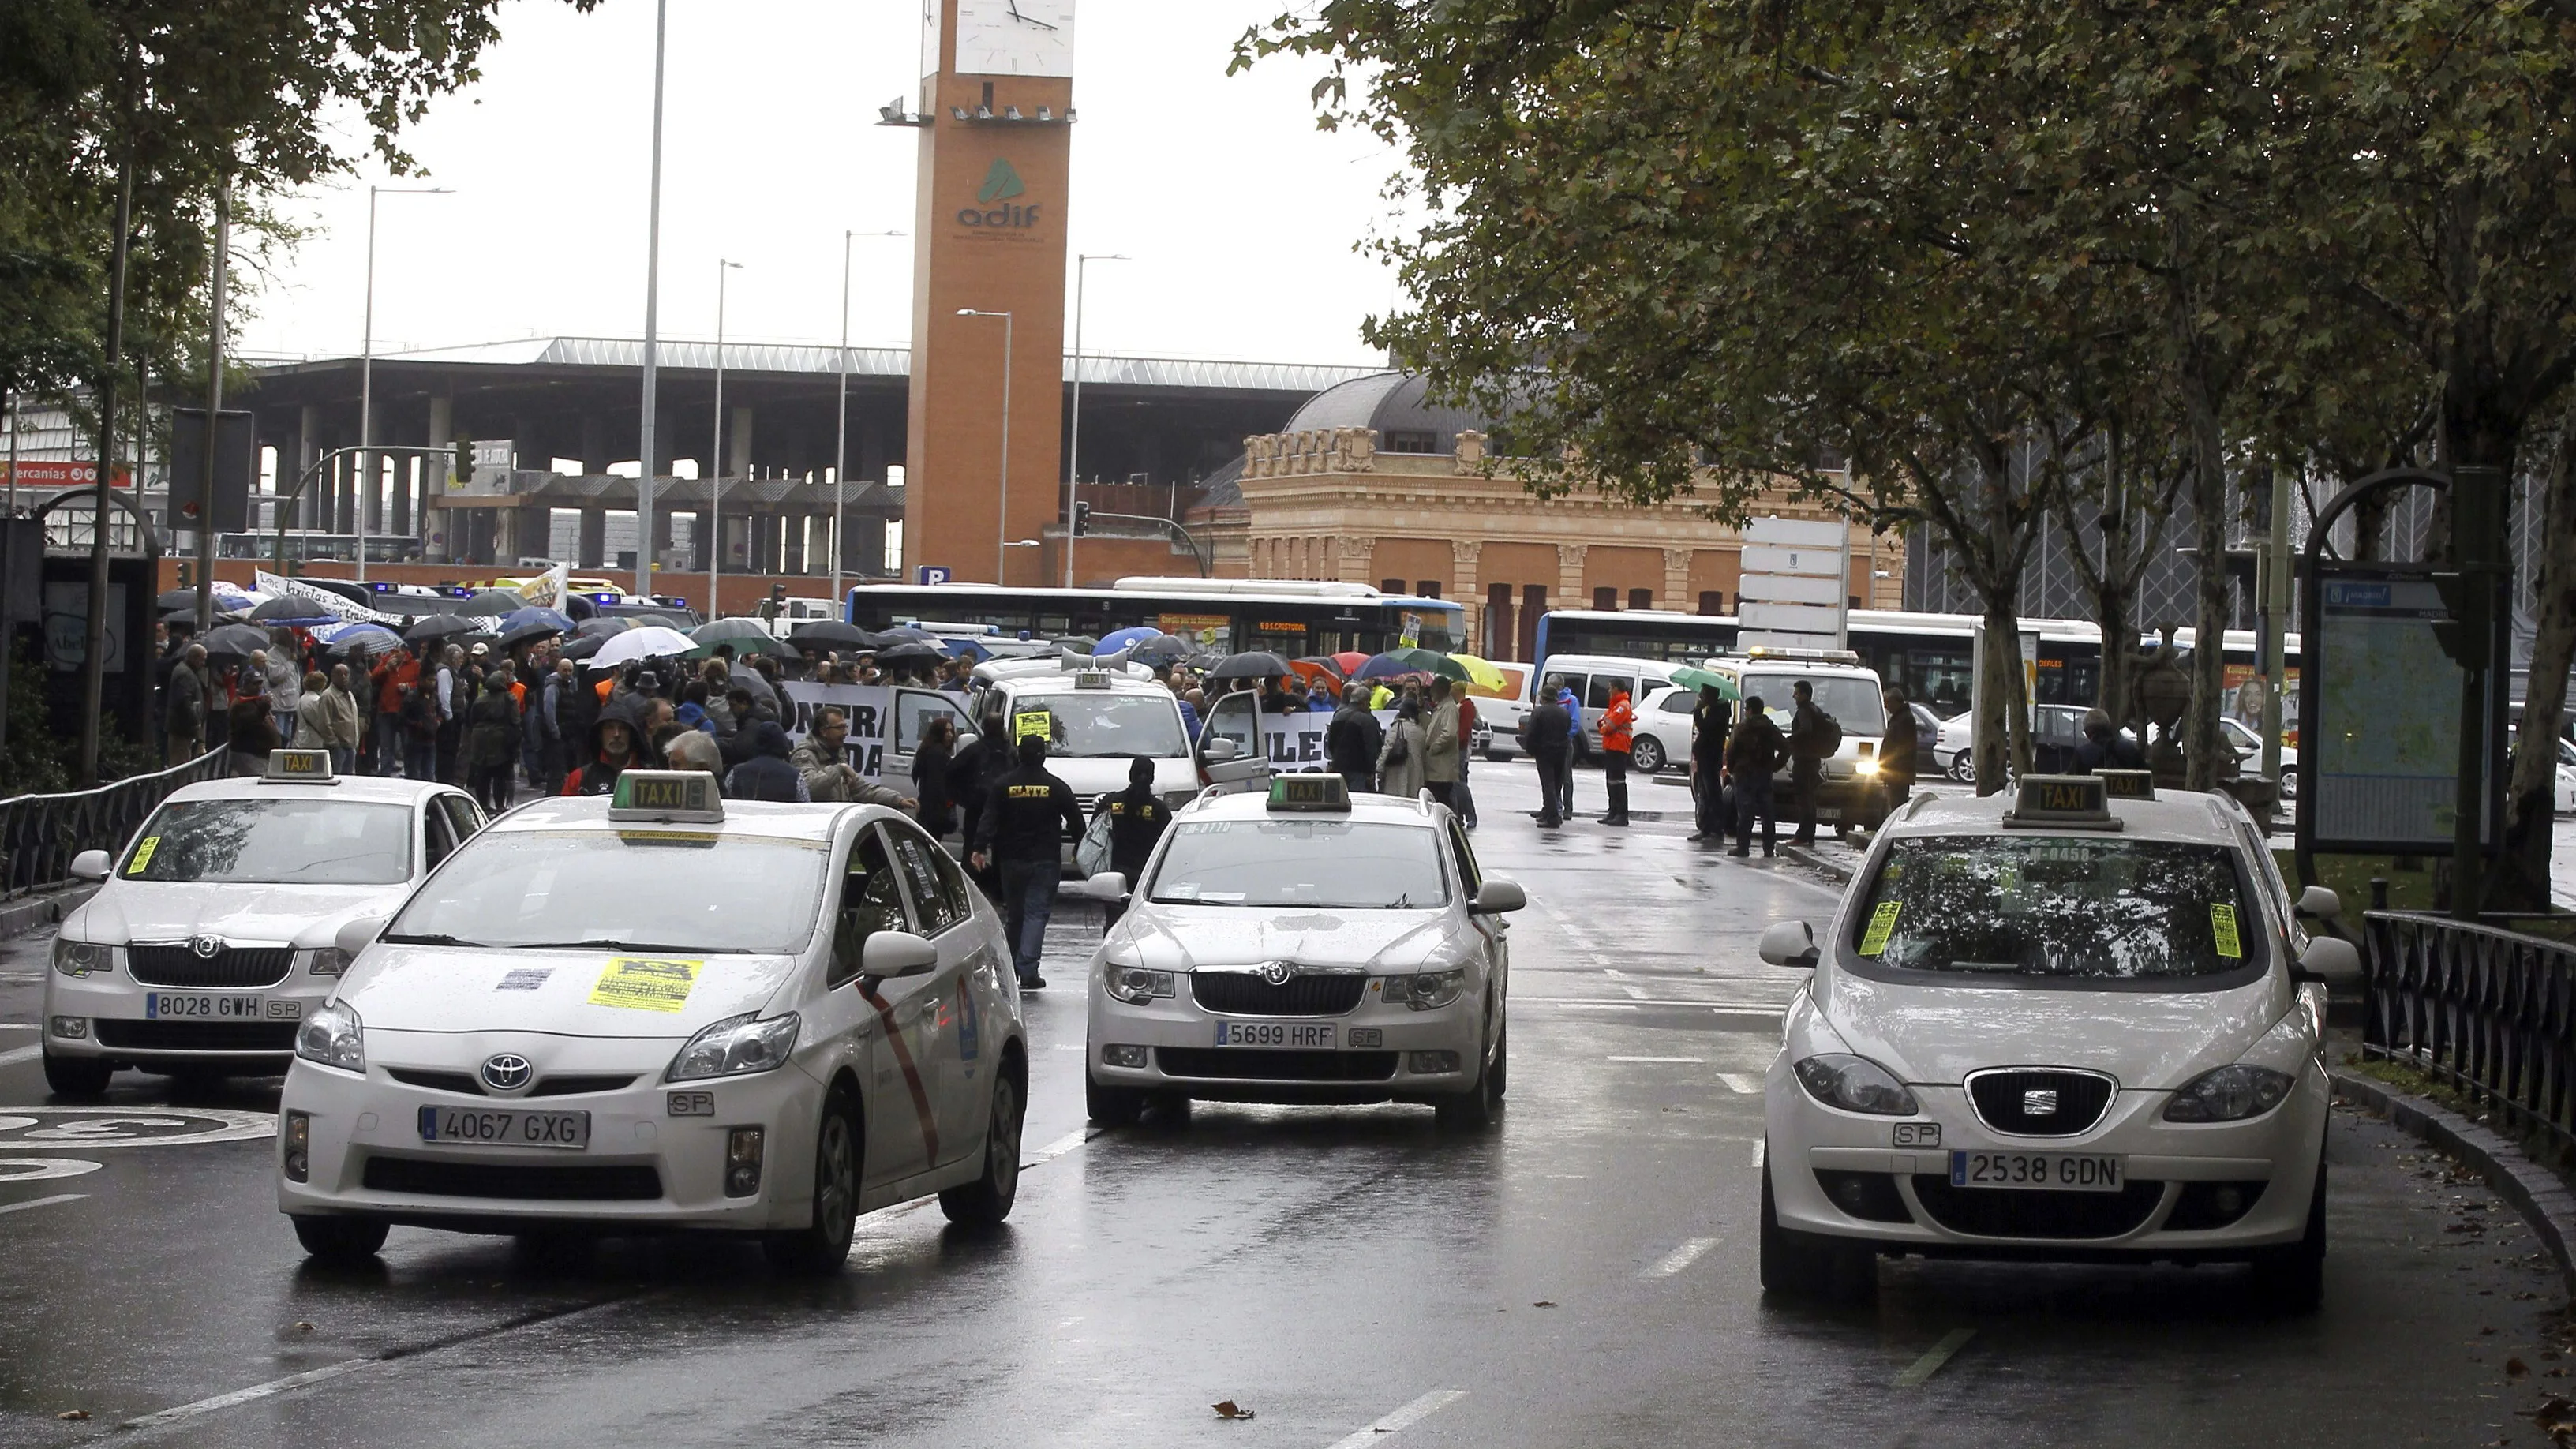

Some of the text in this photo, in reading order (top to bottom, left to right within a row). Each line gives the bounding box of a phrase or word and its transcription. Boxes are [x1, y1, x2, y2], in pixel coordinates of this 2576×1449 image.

[9, 467, 66, 480] ercanías
[928, 569, 944, 586] P
[285, 578, 328, 603] Taxistas
[284, 754, 313, 771] TAXI
[637, 782, 680, 804] TAXI
[1009, 785, 1050, 798] ELITE
[1290, 782, 1322, 799] TAXI
[2107, 777, 2138, 793] TAXI
[2041, 784, 2084, 808] TAXI
[2029, 848, 2090, 862] M-0458
[160, 997, 257, 1016] 8028 GWH
[270, 1003, 298, 1016] SP
[1231, 1025, 1331, 1046] 5699 HRF
[1353, 1031, 1378, 1043] SP
[672, 1095, 709, 1112] SP
[444, 1112, 576, 1143] 4067 GXG
[1898, 1126, 1935, 1144] SP
[1972, 1155, 2116, 1185] 2538 GDN
